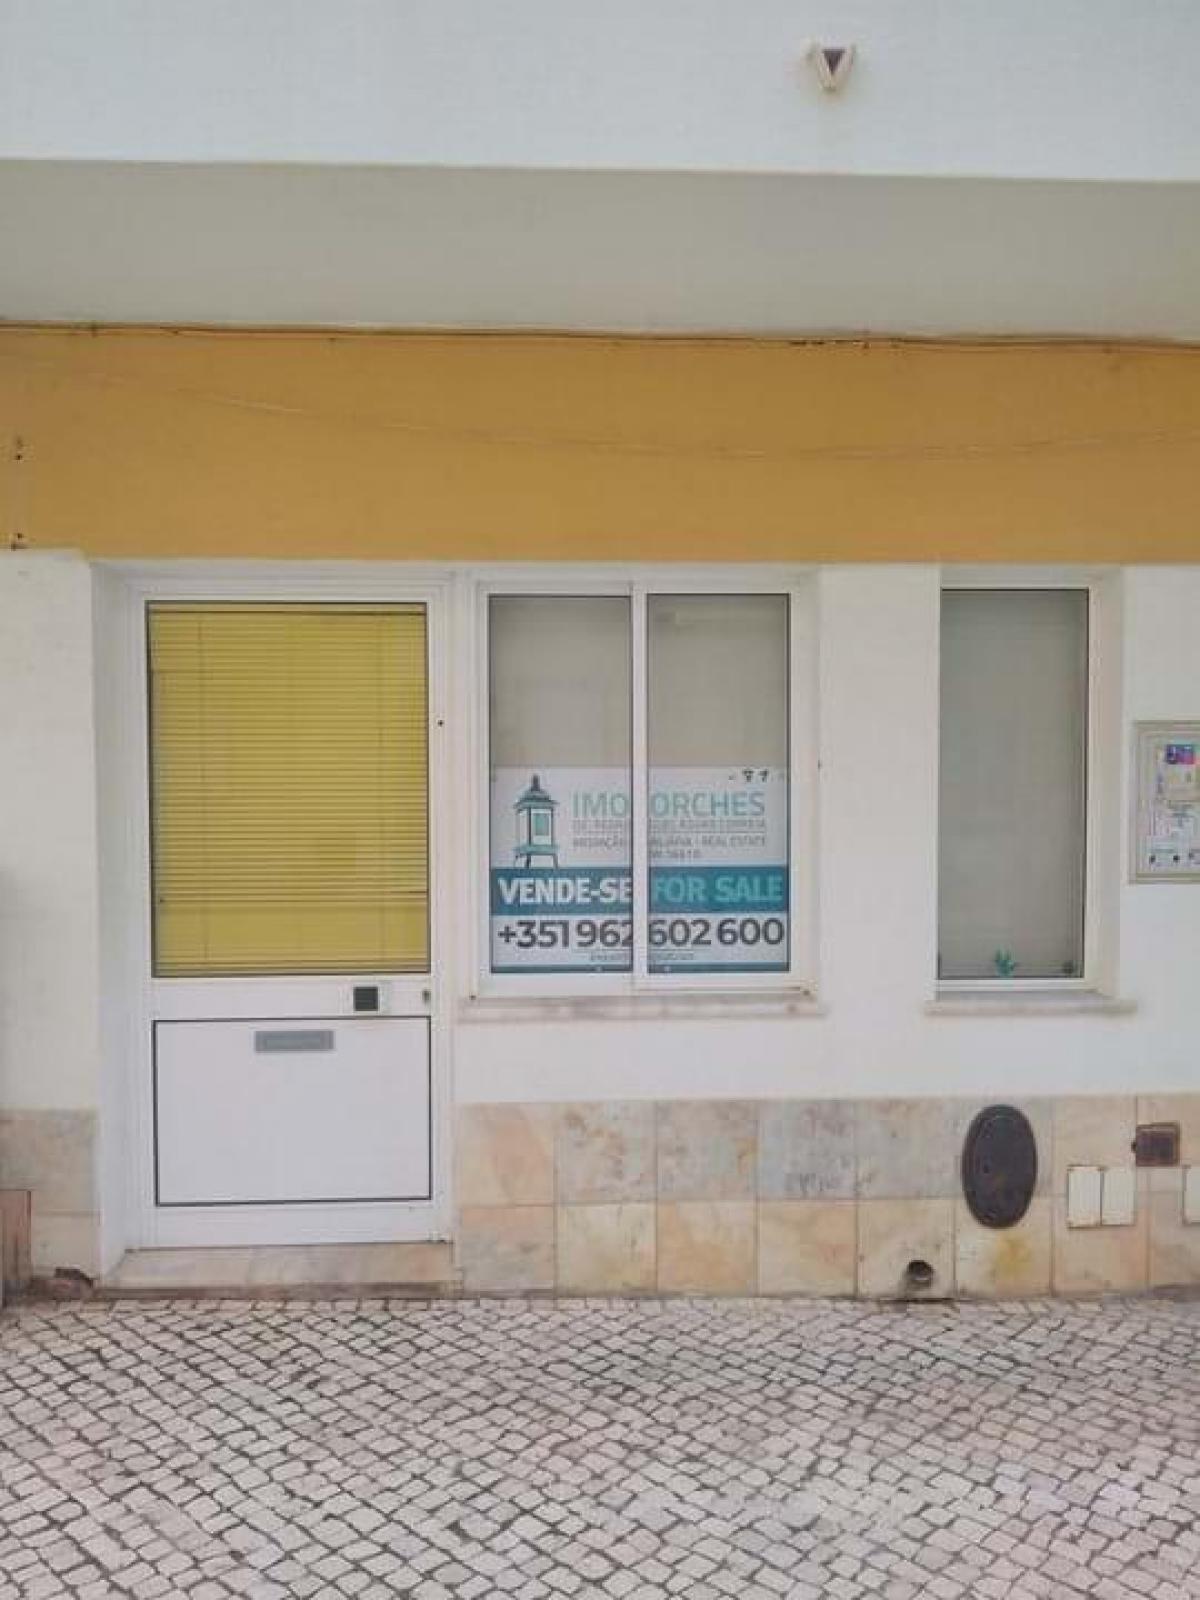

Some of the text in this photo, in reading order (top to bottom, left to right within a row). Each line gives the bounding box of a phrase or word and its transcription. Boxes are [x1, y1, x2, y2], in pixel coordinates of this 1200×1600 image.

[572, 790, 766, 818] IMOORCHES
[498, 875, 784, 905] VENDE-SE FOR SALE
[498, 919, 570, 948] +351
[648, 917, 712, 946] 602
[717, 917, 785, 946] 600
